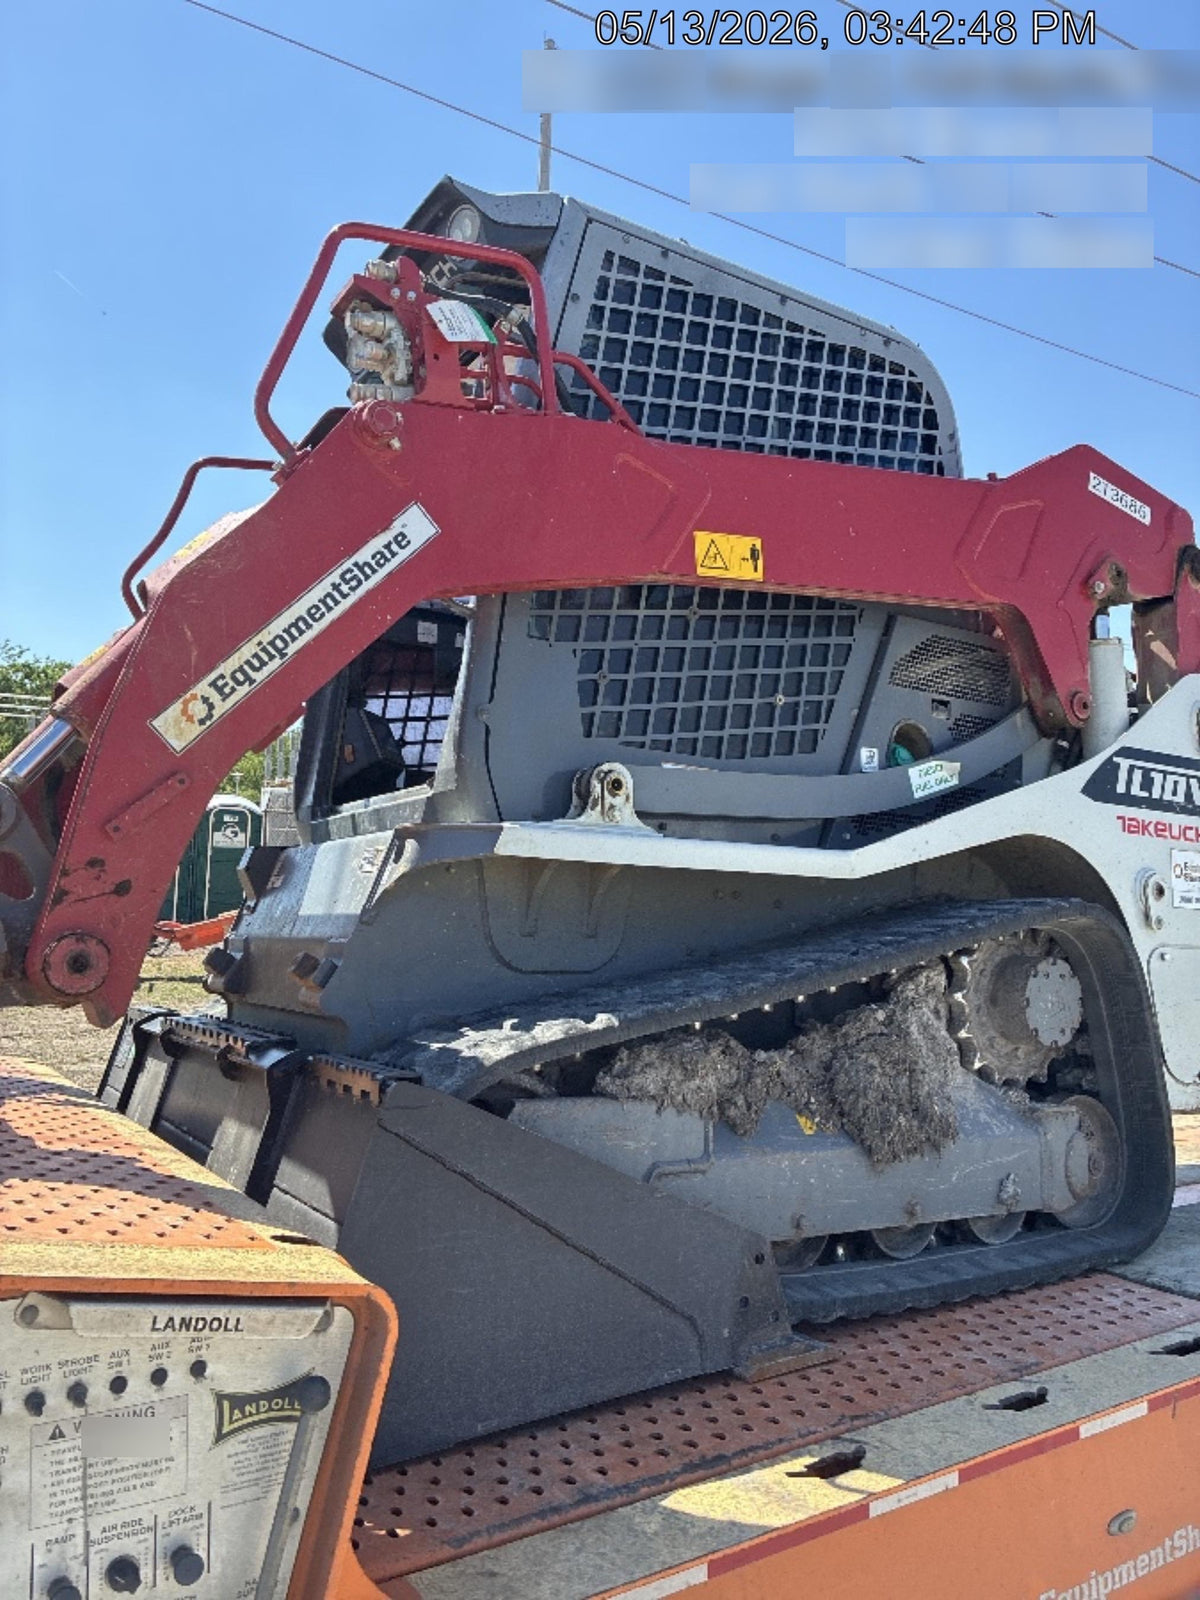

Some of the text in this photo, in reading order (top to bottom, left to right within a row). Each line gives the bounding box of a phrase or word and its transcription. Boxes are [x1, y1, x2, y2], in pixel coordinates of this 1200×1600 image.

[207, 529, 412, 703] EquipmentShare
[151, 1315, 244, 1333] LANDOLL
[57, 1354, 100, 1369] STROBE
[20, 1372, 51, 1385] LIGHT
[63, 1365, 93, 1378] LIGHT
[101, 1518, 144, 1535] AIR RIDE
[89, 1525, 154, 1548] SUSPENSION
